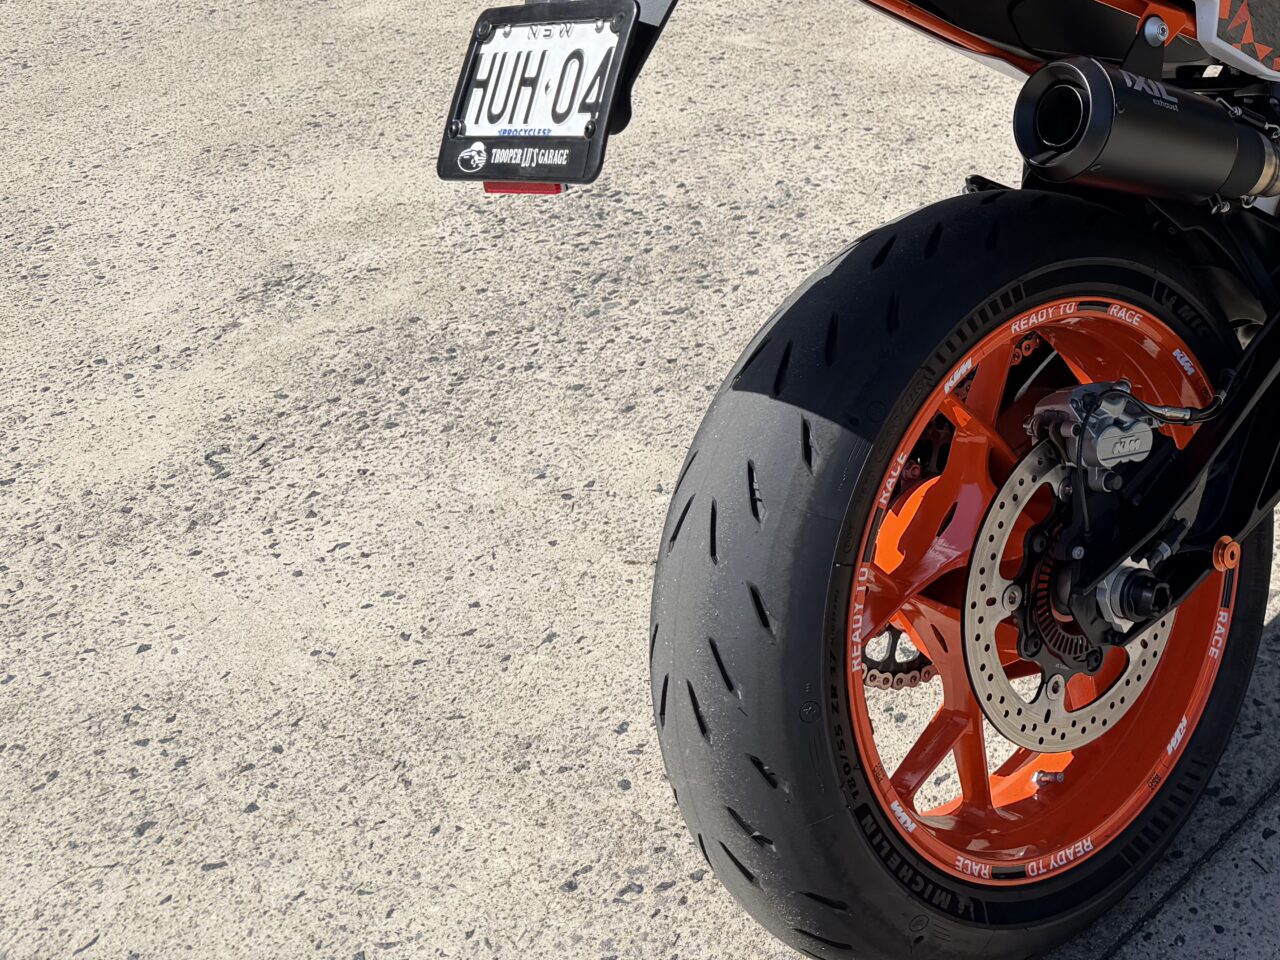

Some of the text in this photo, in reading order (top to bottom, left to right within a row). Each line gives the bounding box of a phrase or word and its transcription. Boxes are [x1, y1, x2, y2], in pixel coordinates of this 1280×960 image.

[1152, 98, 1179, 113] exhaust
[491, 147, 569, 167] TROOPER LU'S GARAGE
[1010, 301, 1143, 334] READY TO RACE
[944, 357, 973, 394] KTM
[1173, 348, 1195, 376] KTM
[1111, 436, 1141, 455] KTM
[852, 602, 864, 673] READY
[1208, 611, 1230, 661] RACE
[890, 800, 918, 833] KTM
[860, 815, 951, 909] MICHELIN
[955, 836, 1094, 879] READY TO RACE
